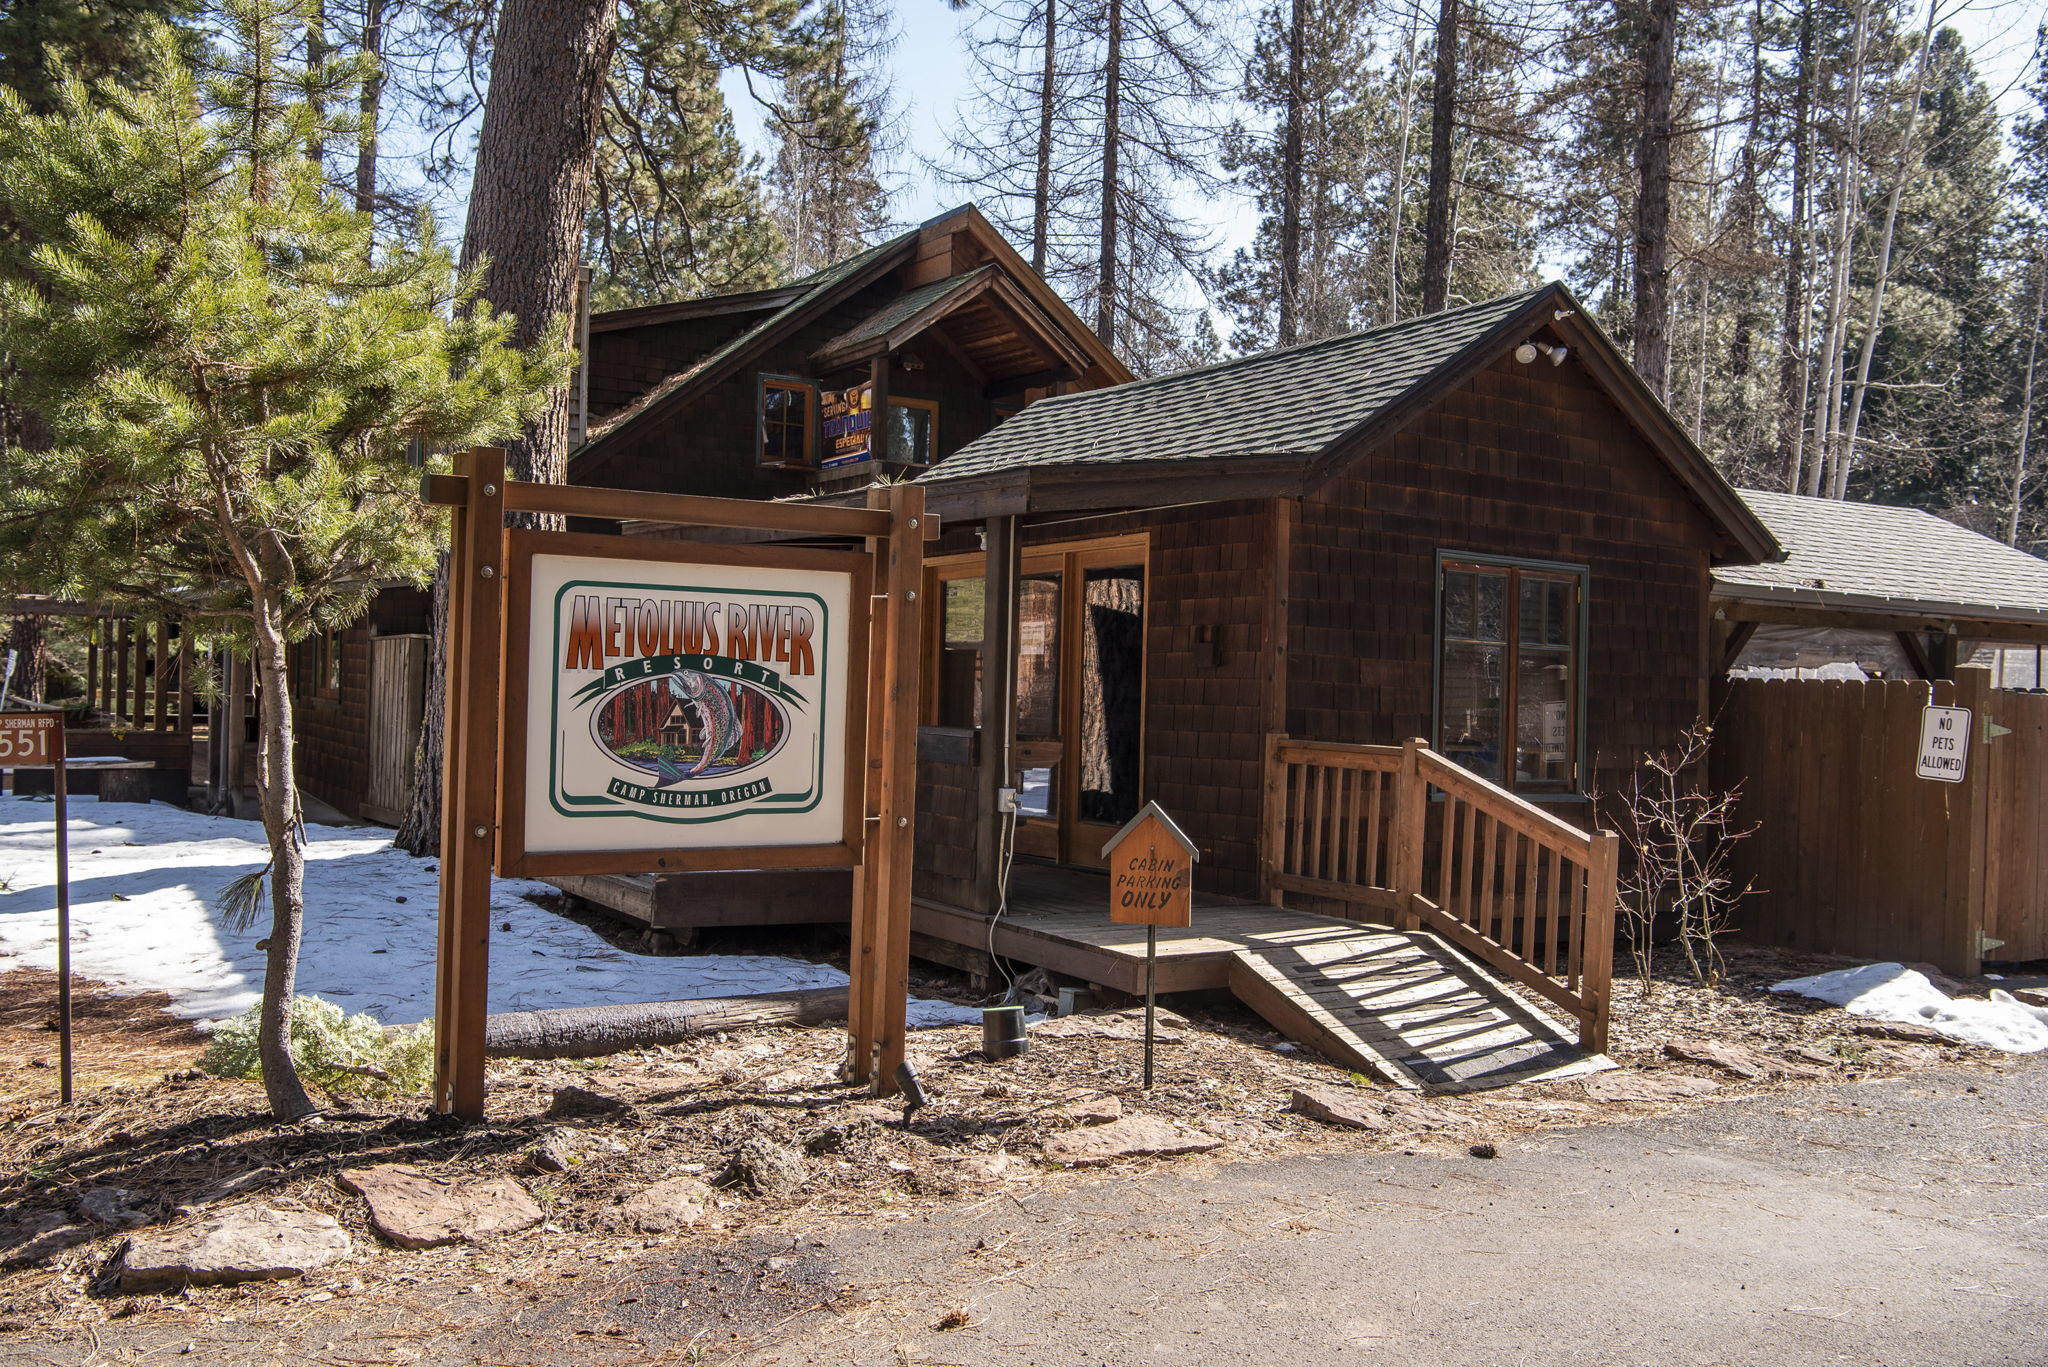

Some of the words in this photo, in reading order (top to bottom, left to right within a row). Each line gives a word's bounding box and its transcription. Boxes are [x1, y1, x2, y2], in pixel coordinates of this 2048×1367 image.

[565, 595, 721, 671] METOLIUS
[727, 603, 815, 675] RIVER
[615, 656, 770, 684] RESORT
[4, 718, 36, 729] SHERMAN
[1938, 717, 1953, 731] NO
[0, 729, 46, 757] 551
[1932, 736, 1955, 751] PETS
[1921, 755, 1961, 771] ALLOWED
[612, 781, 645, 801] CAMP
[652, 791, 714, 806] SHERMAN,
[721, 780, 766, 803] OREGON
[1128, 858, 1175, 872] CABIN
[1116, 874, 1182, 890] PARKING
[1120, 890, 1172, 910] ONLY
